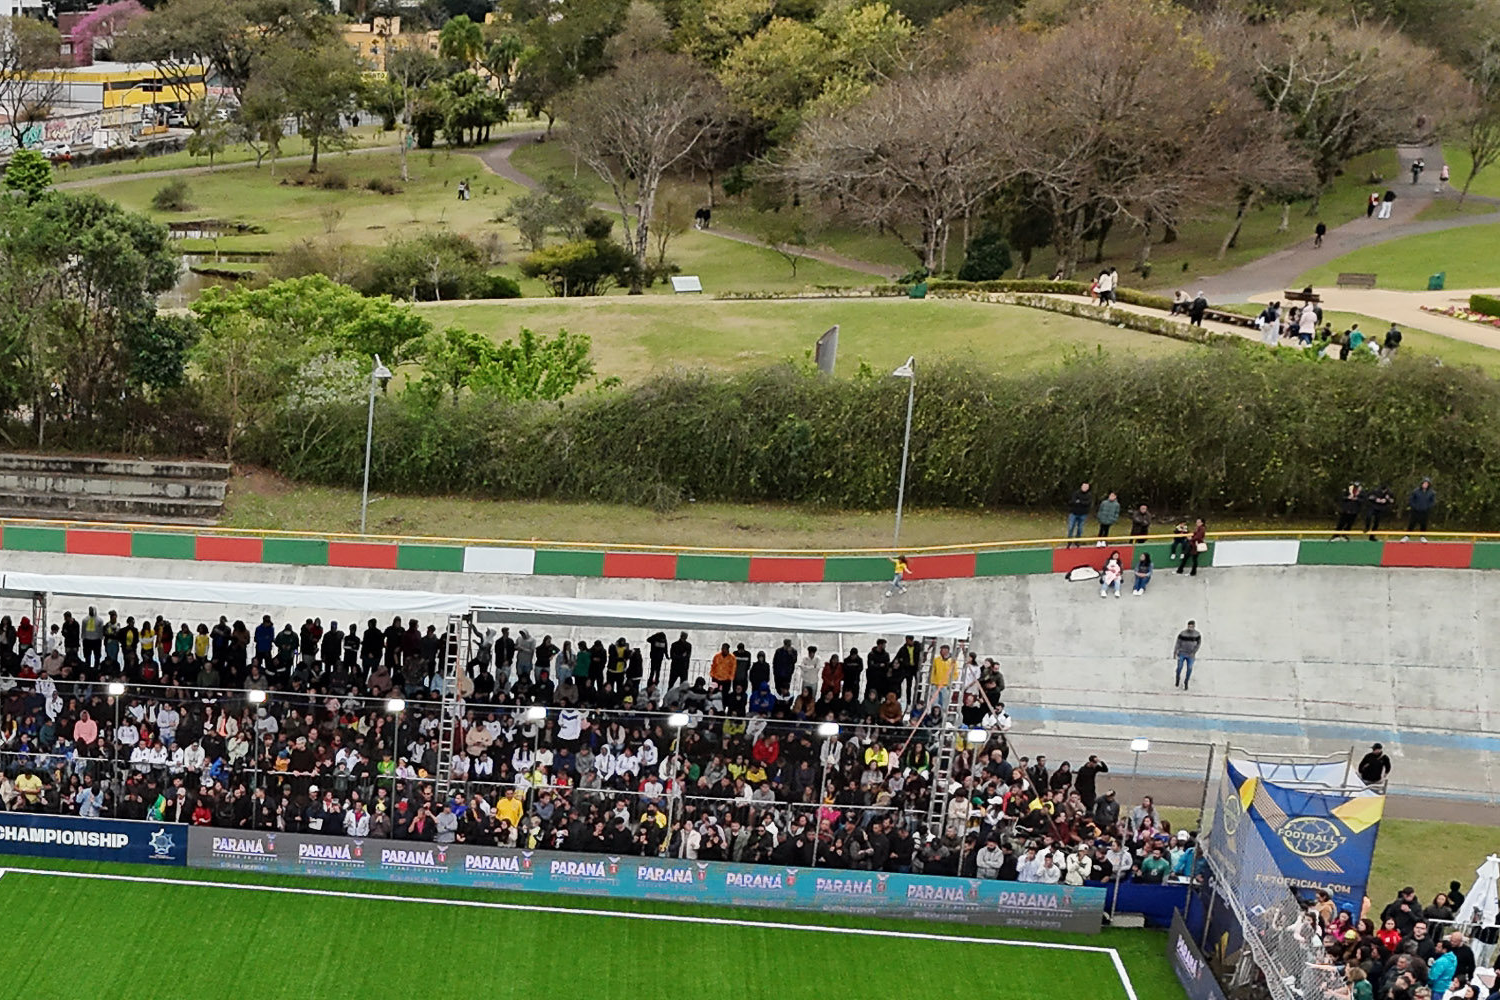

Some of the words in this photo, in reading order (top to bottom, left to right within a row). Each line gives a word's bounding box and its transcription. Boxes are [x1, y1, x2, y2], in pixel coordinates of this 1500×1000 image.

[1277, 828, 1335, 843] FOOTBALL
[1339, 836, 1347, 844] 7
[212, 837, 264, 854] PARANÁ
[299, 843, 351, 860] PARANÁ
[381, 849, 434, 866] PARANÁ
[465, 855, 519, 871] PARANÁ
[551, 860, 605, 877] PARANÁ
[638, 866, 693, 883] PARANÁ
[726, 872, 782, 889] PARANÁ
[816, 878, 872, 894] PARANÁ
[907, 884, 964, 901] PARANÁ
